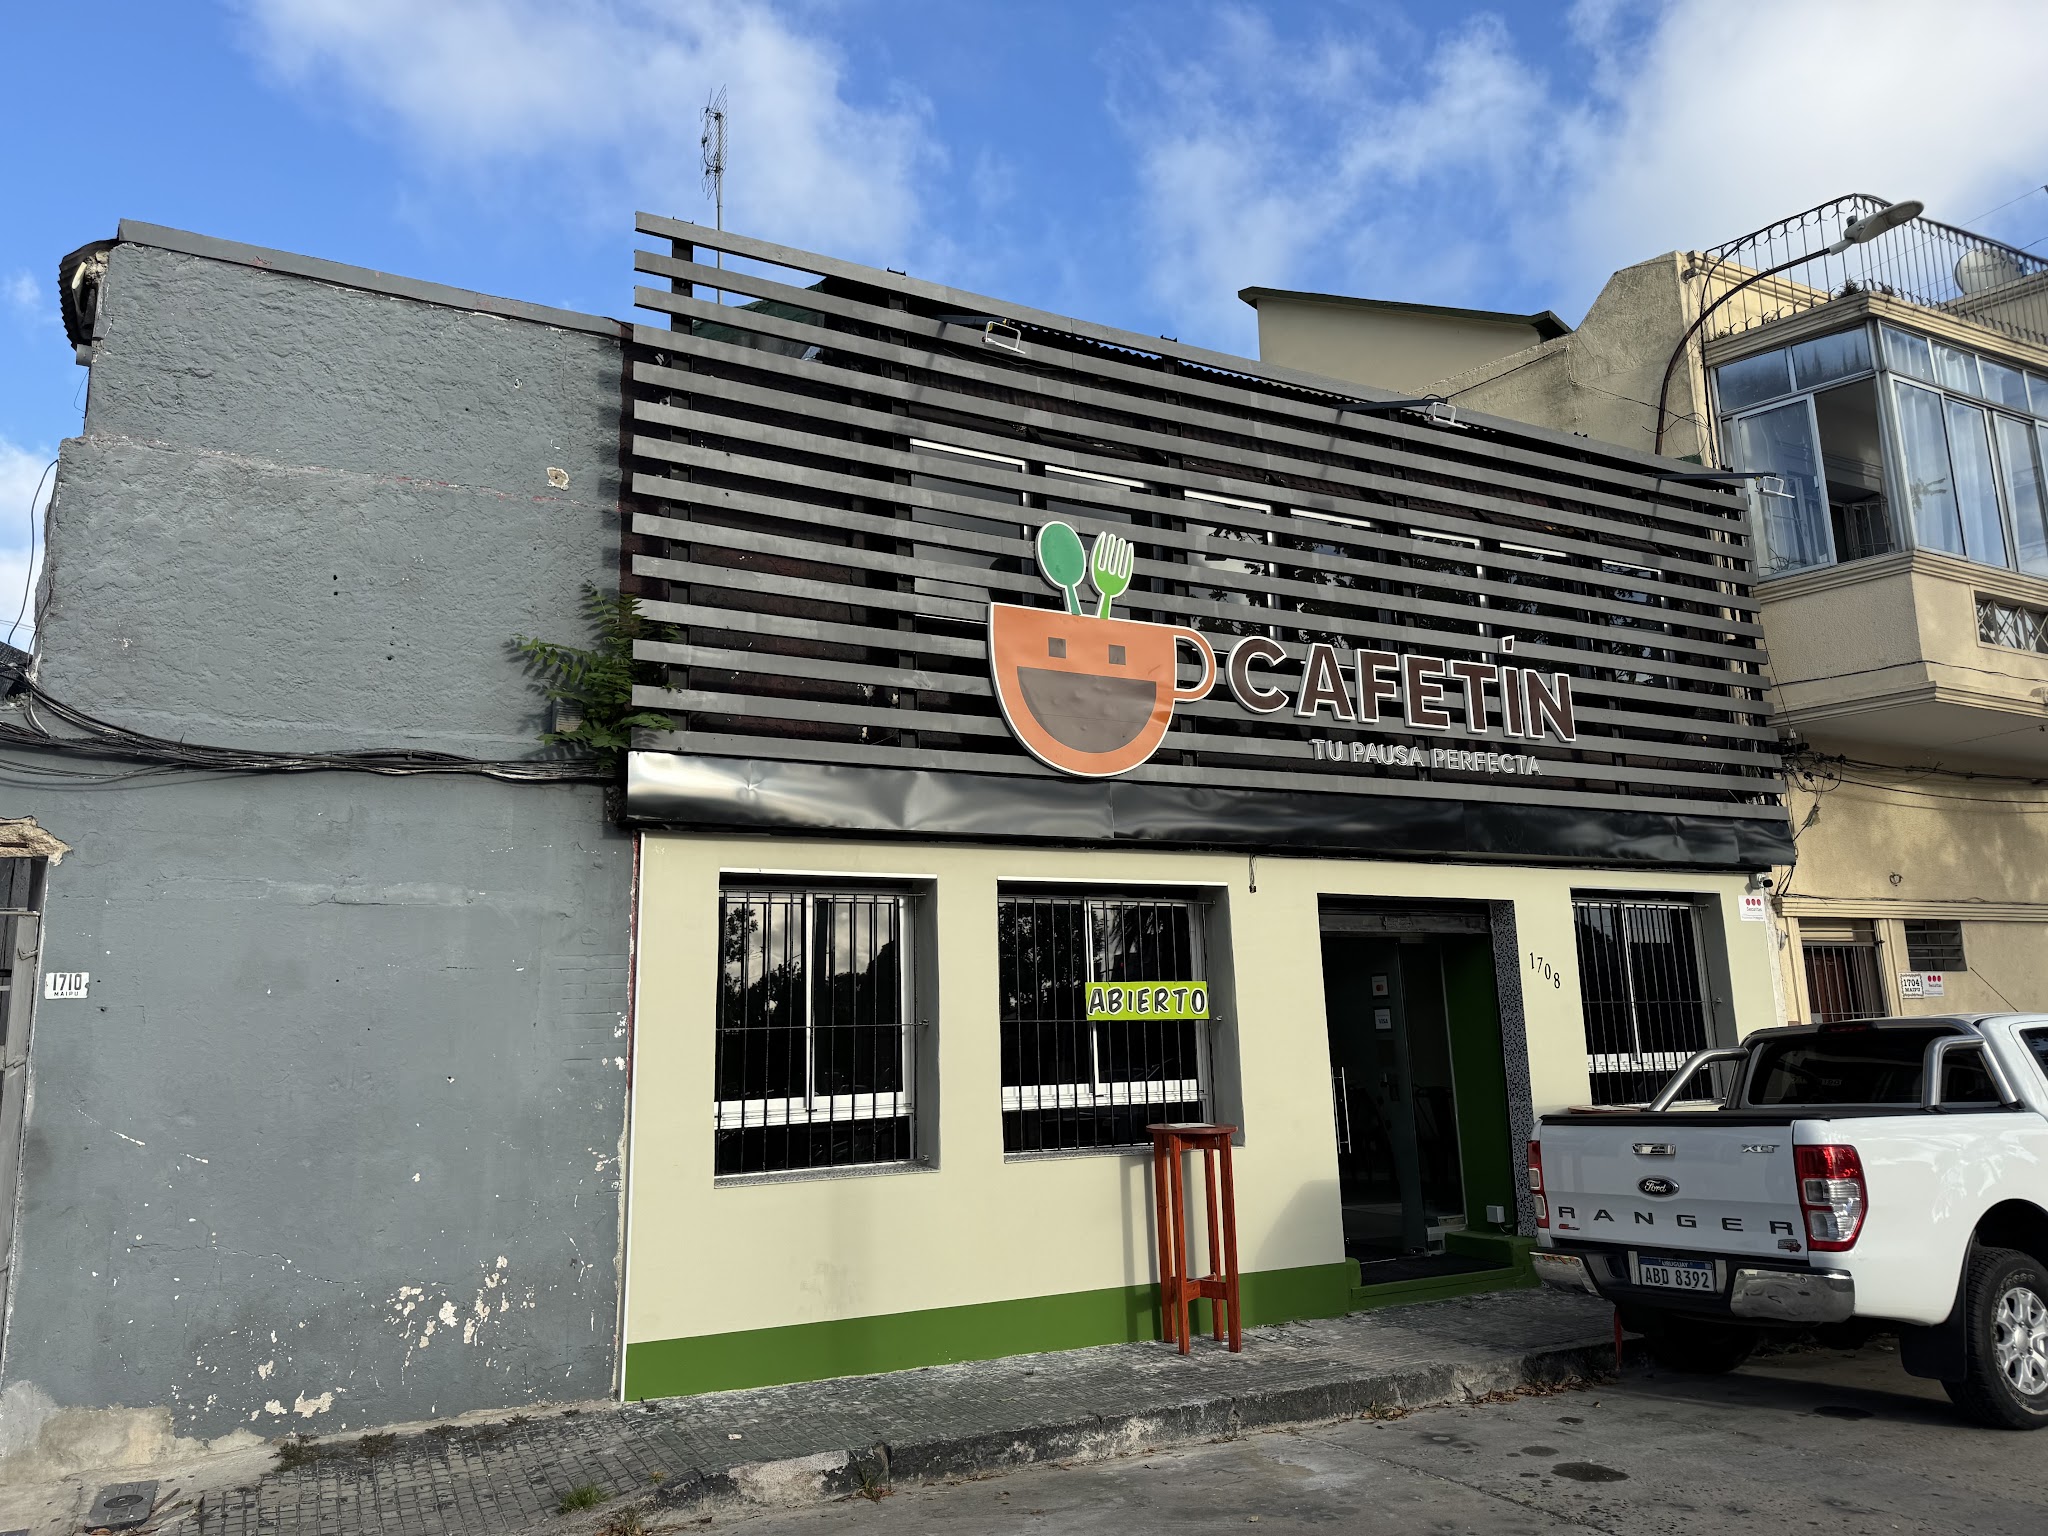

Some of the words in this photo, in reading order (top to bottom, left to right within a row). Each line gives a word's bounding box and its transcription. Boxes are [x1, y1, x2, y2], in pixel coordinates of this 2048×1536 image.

[1226, 635, 1576, 742] CAFETÍN
[1310, 739, 1343, 761] TU
[1350, 742, 1425, 767] PAUSA
[1431, 748, 1542, 775] PERFECTA
[1529, 952, 1561, 989] 1708
[52, 973, 83, 991] 1710
[1903, 979, 1920, 987] 1704
[1087, 986, 1207, 1015] ABIERTO
[1741, 1144, 1780, 1153] XLT
[1644, 1179, 1667, 1193] Ford
[1558, 1206, 1794, 1236] RANGER
[1661, 1260, 1689, 1268] URUGUAY
[1645, 1267, 1669, 1285] ABD
[1675, 1269, 1710, 1289] 8392
